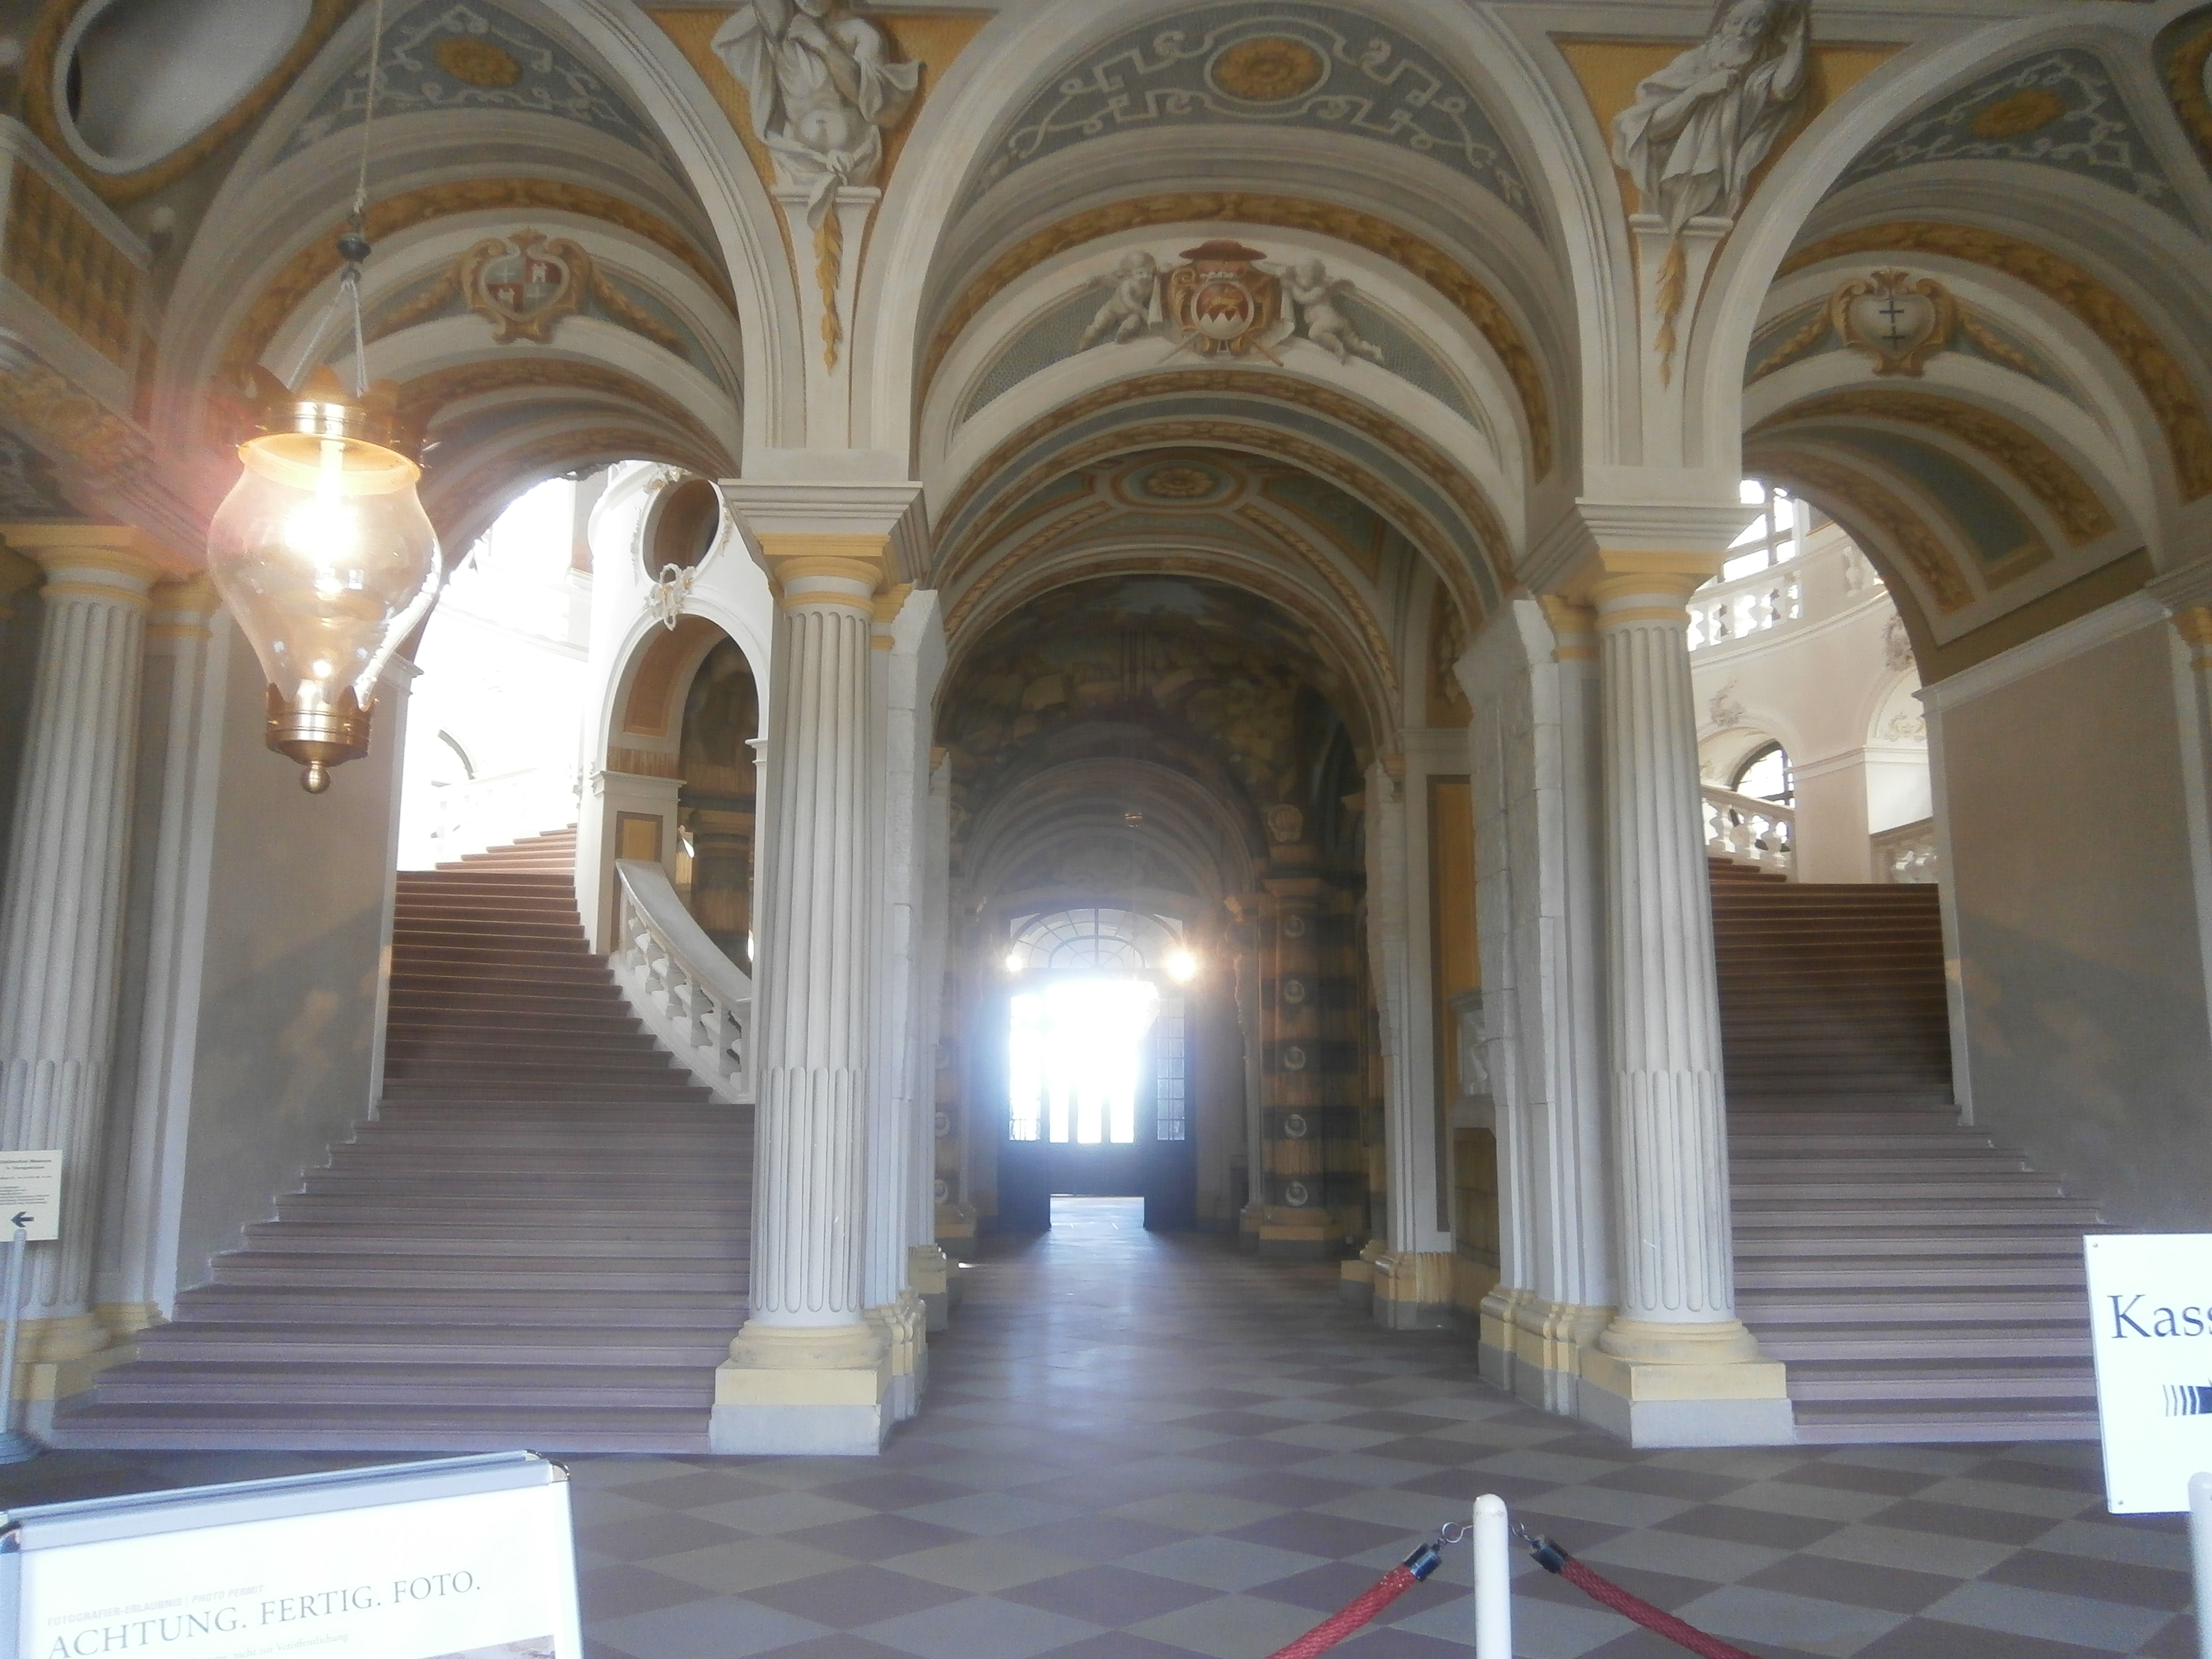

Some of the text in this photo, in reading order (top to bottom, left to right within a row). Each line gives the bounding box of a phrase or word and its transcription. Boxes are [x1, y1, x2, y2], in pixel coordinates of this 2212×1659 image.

[2107, 1294, 2212, 1339] Kas
[47, 1597, 183, 1627] FOTOGRAFIER-ERLAUBNIS
[191, 1590, 225, 1604] PHOTO
[227, 1585, 265, 1598] PERMIT
[48, 1570, 481, 1659] ACHTUNG. FERTIG. FOTO.
